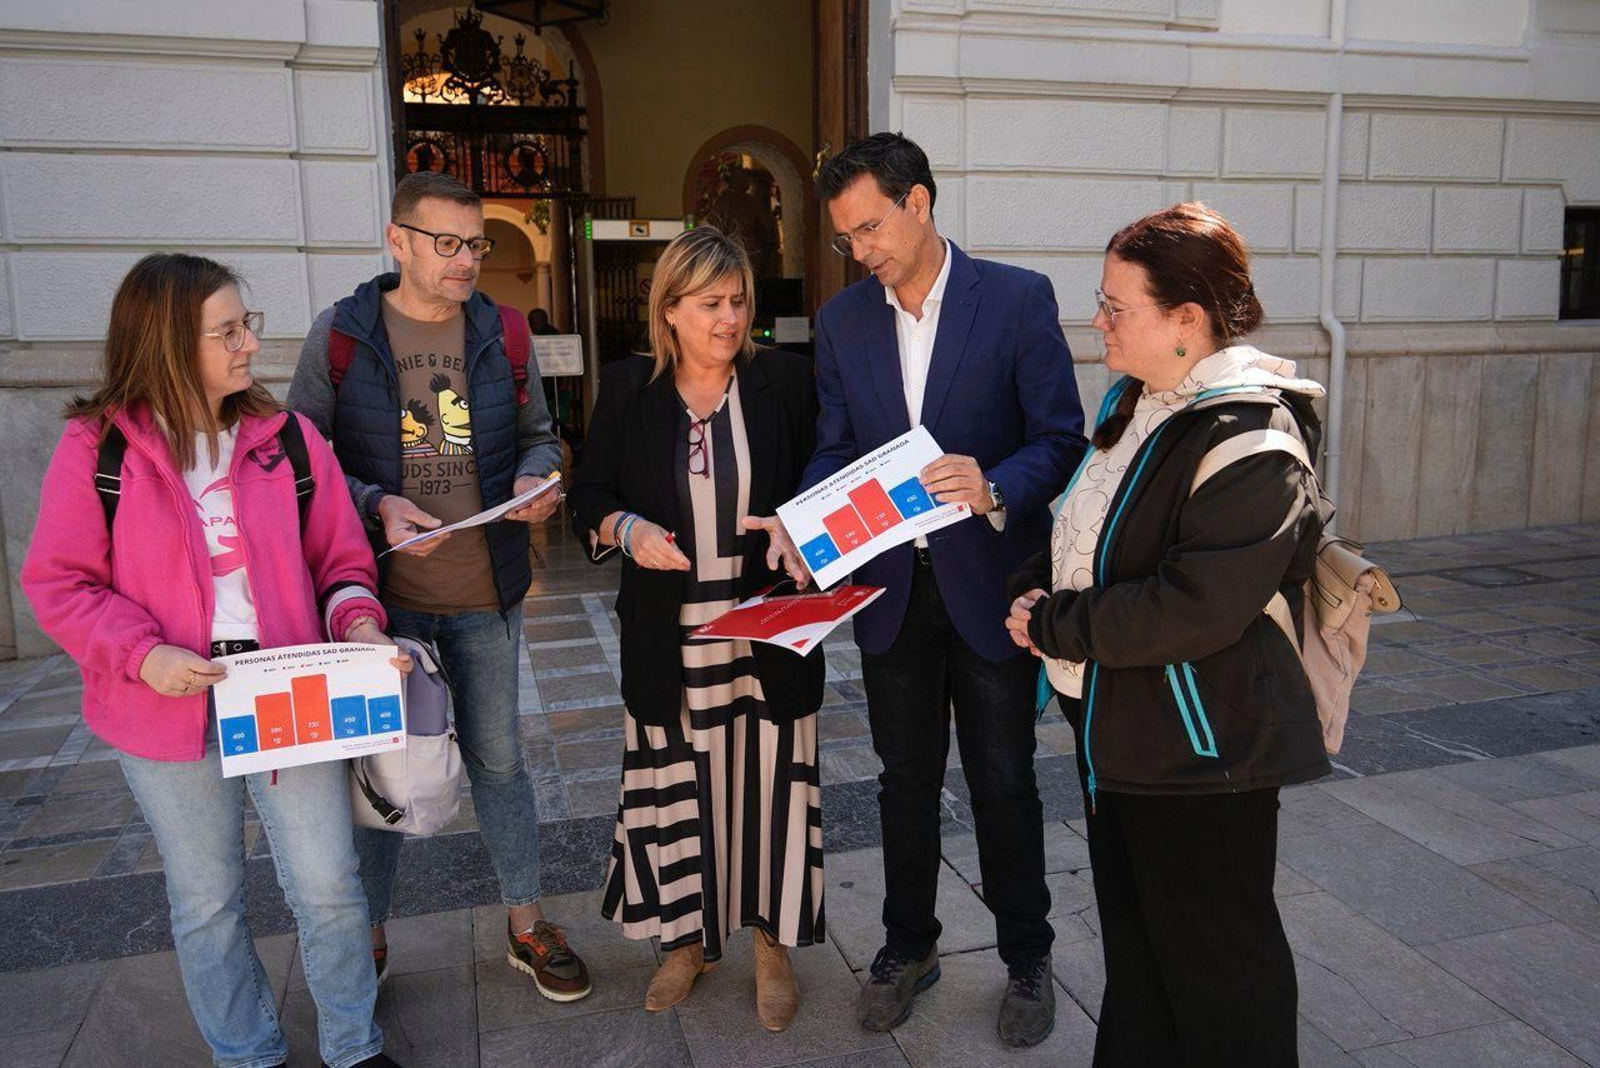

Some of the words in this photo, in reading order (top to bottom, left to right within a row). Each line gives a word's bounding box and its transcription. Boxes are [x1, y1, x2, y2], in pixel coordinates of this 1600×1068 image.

[428, 353, 437, 367] &
[795, 485, 828, 506] PERSONAS
[829, 464, 864, 487] ATENDIDAS
[863, 457, 877, 467] SAD
[878, 439, 910, 459] GRANADA
[420, 479, 451, 496] 1973
[235, 655, 276, 666] PERSONAS
[277, 649, 321, 660] ATENDIDAS
[232, 732, 246, 740] 400
